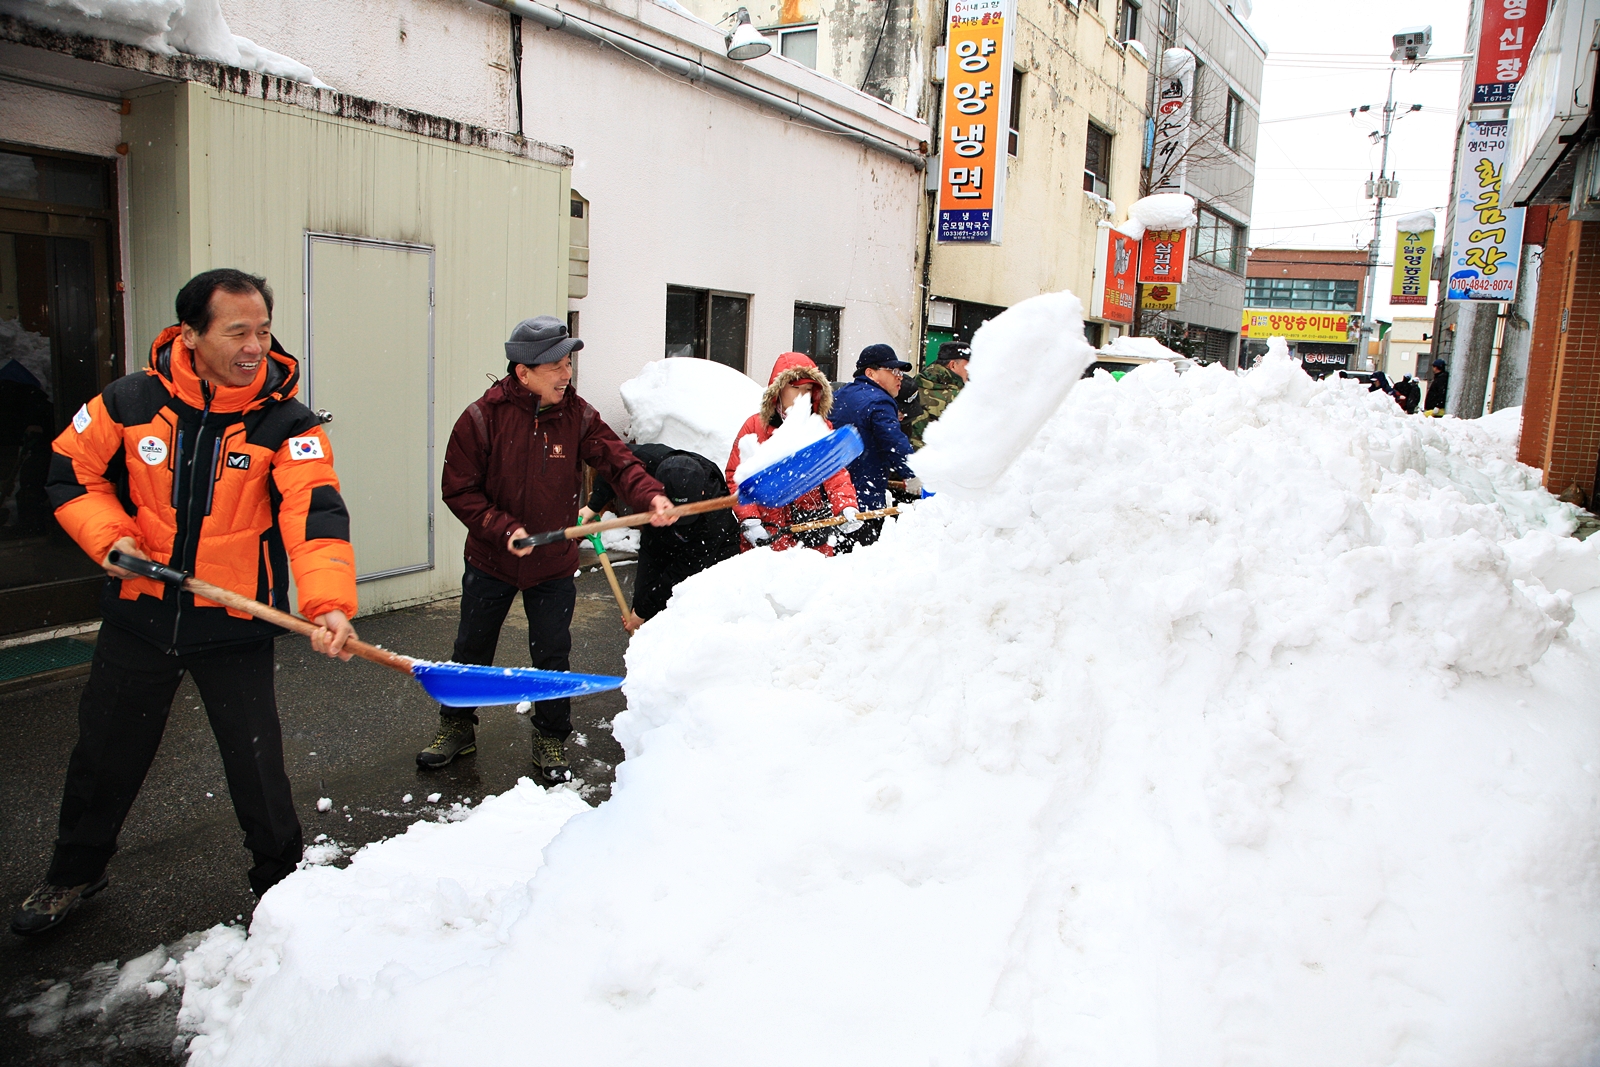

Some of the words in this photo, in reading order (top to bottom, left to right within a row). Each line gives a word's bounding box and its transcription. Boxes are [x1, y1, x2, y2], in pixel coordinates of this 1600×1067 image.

[948, 38, 996, 200] 양양냉면
[1153, 243, 1173, 275] 삼겹살
[1450, 278, 1513, 291] 010-4842-8074
[1269, 315, 1347, 332] 양양송이마을
